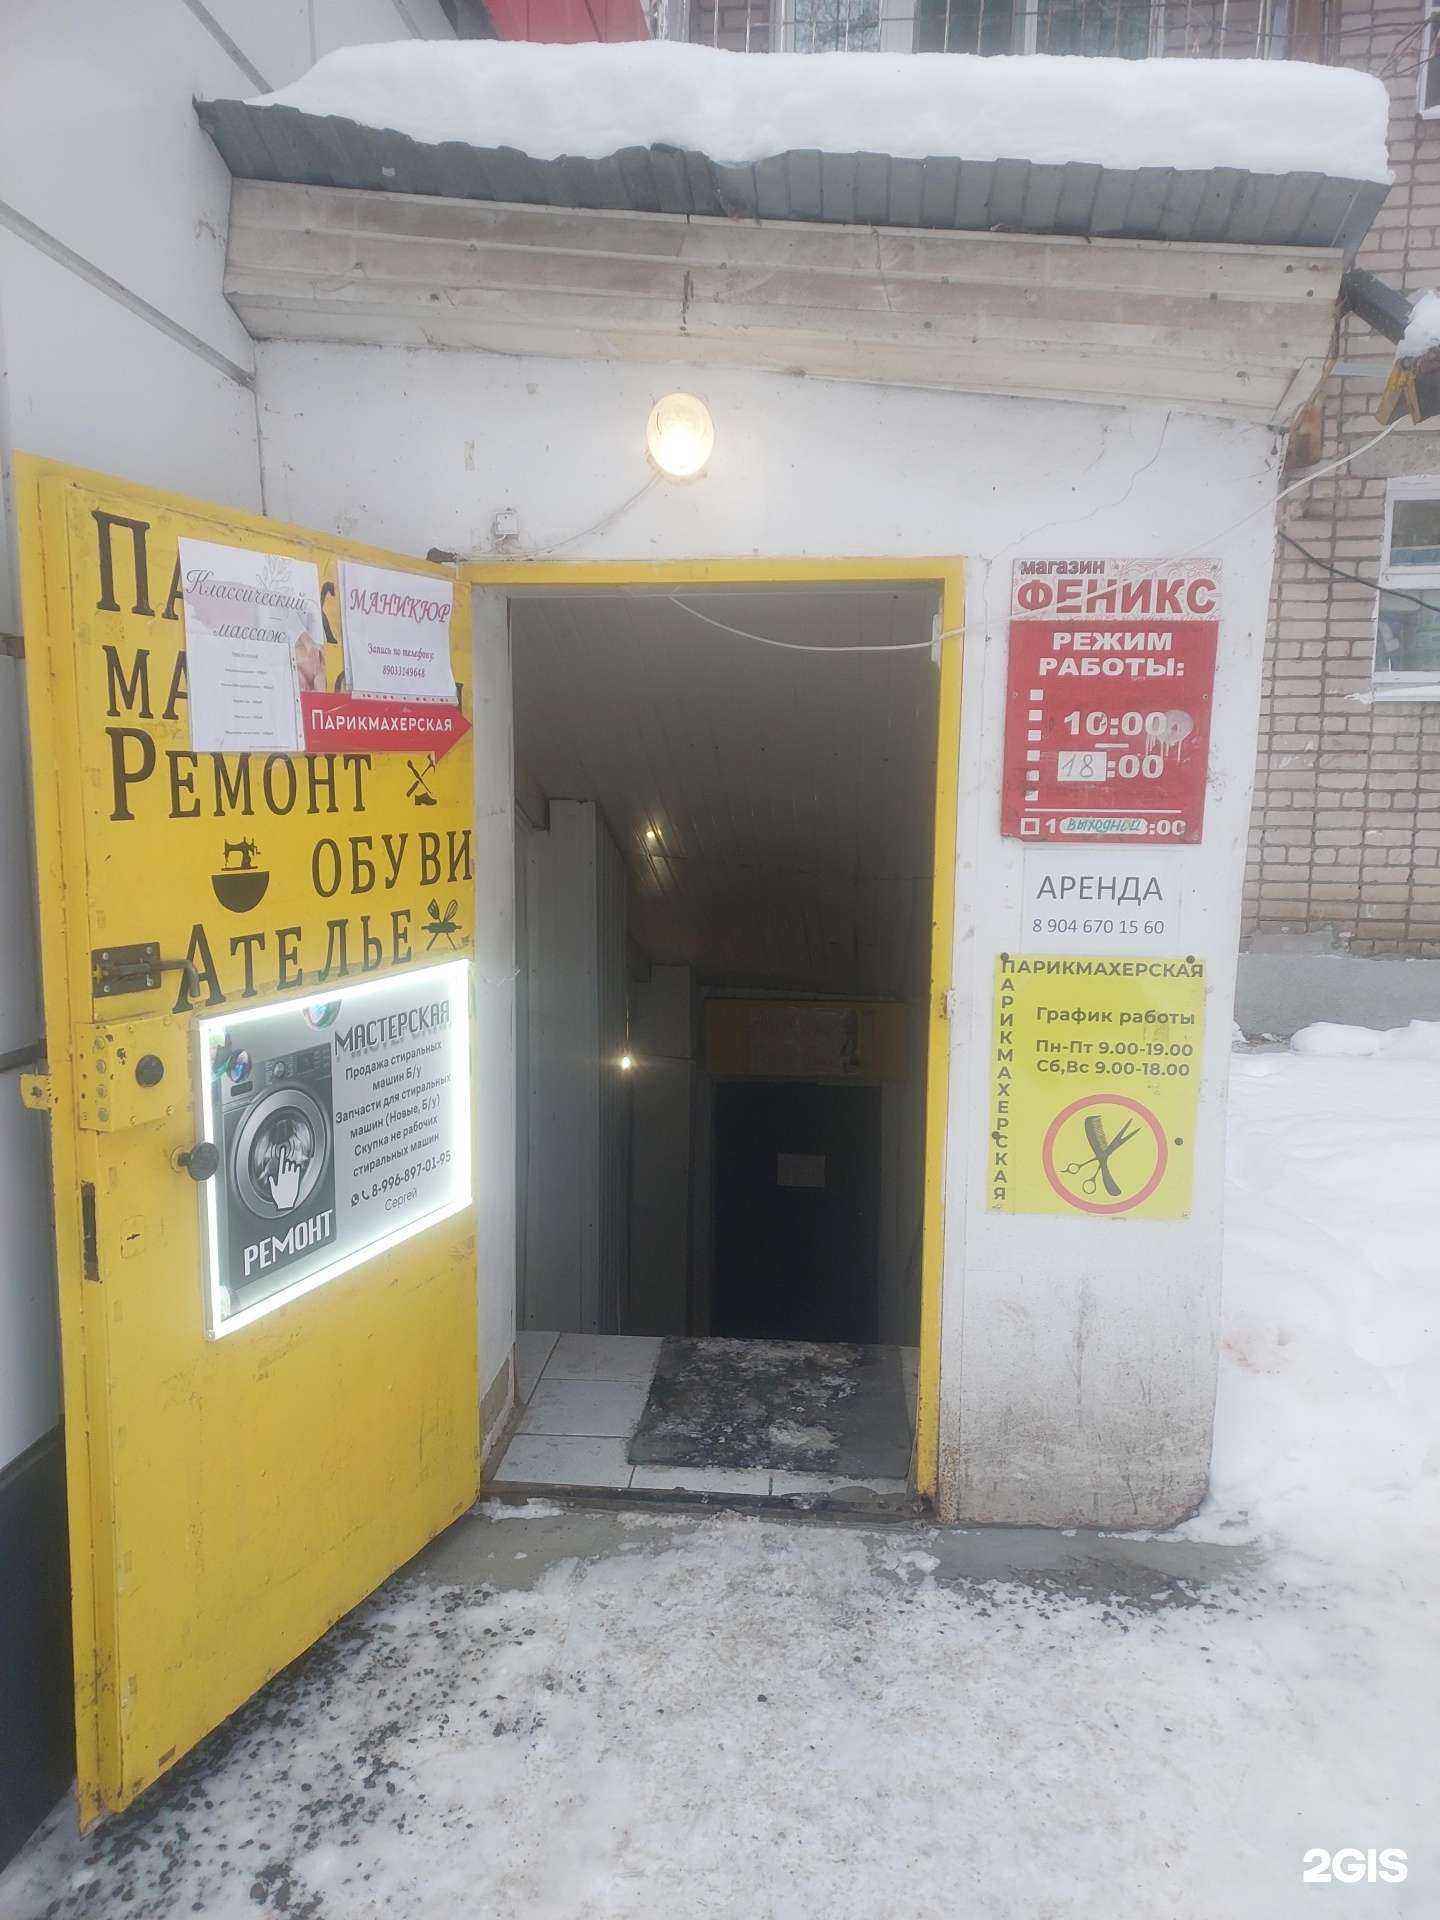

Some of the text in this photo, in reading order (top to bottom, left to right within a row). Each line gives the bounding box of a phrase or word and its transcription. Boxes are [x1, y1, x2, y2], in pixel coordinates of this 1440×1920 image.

[1020, 559, 1105, 575] магазин
[186, 568, 306, 614] Классический
[1017, 578, 1217, 614] ФЕНИКС
[350, 588, 451, 624] МАНИКЮР
[212, 622, 288, 644] массаж
[1053, 632, 1172, 651] РЕЖИМ
[1039, 657, 1185, 676] РАБОТЫ:
[312, 829, 472, 898] ОБУВИ
[1036, 875, 1163, 907] АРЕНДА
[1032, 919, 1165, 935] 8 904 670 15 60
[1002, 960, 1204, 978] ПАРИКМАХЕРСКАЯ
[334, 1000, 450, 1056] МАСТЕРСКАЯ
[1036, 1007, 1196, 1026] График работы
[345, 1041, 443, 1080] Продажа стиральных
[1036, 1040, 1194, 1056] Пн-Пт 9.00-19.00
[1036, 1060, 1190, 1076] Сб,Вс 9.00-18.00
[372, 1072, 405, 1092] машин
[335, 1097, 382, 1124] Запчасти
[383, 1094, 400, 1109] для
[350, 1119, 384, 1139] машин
[354, 1115, 438, 1157] Скупка не рабочих
[353, 1132, 440, 1177] стиральных машин
[372, 1150, 452, 1198] 8-996-897-01-95
[385, 1187, 418, 1211] Сергей
[244, 1209, 333, 1276] РЕМОНТ
